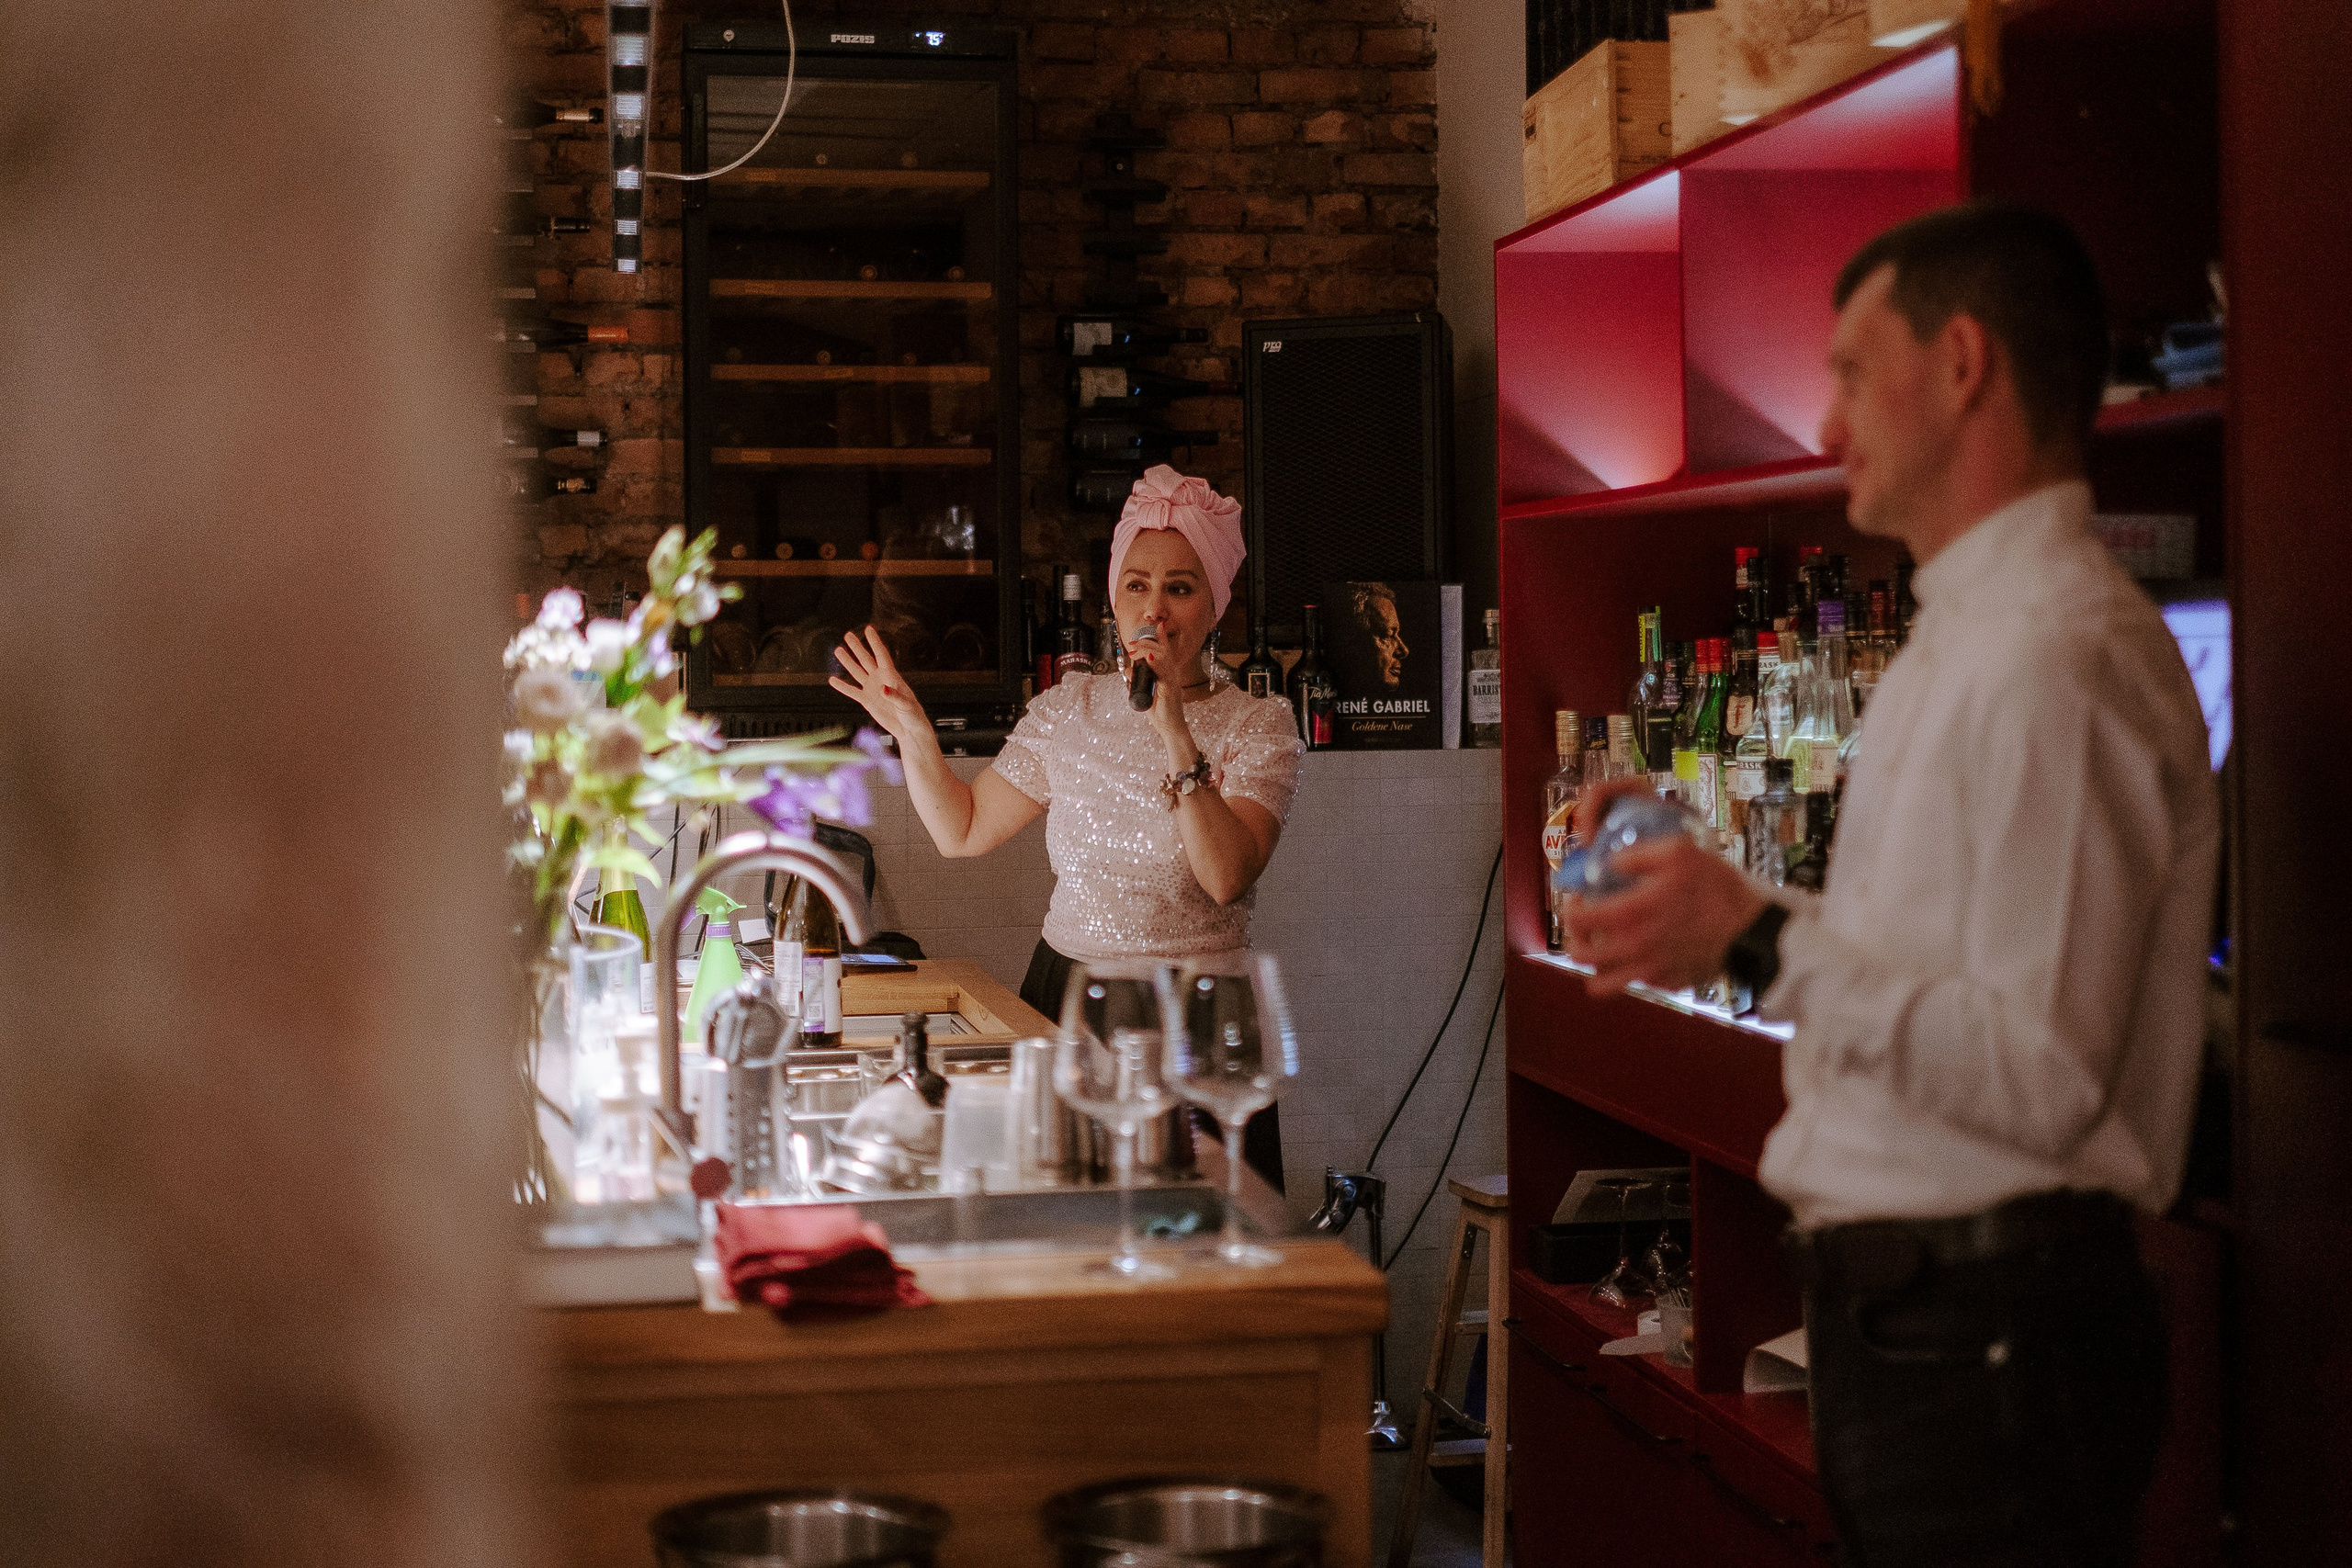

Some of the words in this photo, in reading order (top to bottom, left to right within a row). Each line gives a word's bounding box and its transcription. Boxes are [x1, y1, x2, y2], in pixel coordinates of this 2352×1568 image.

[831, 34, 875, 44] POZIS
[1336, 696, 1368, 714] RENÉ
[1373, 700, 1430, 714] GABRIEL
[1351, 720, 1389, 731] Goldene
[1389, 720, 1413, 731] Nase
